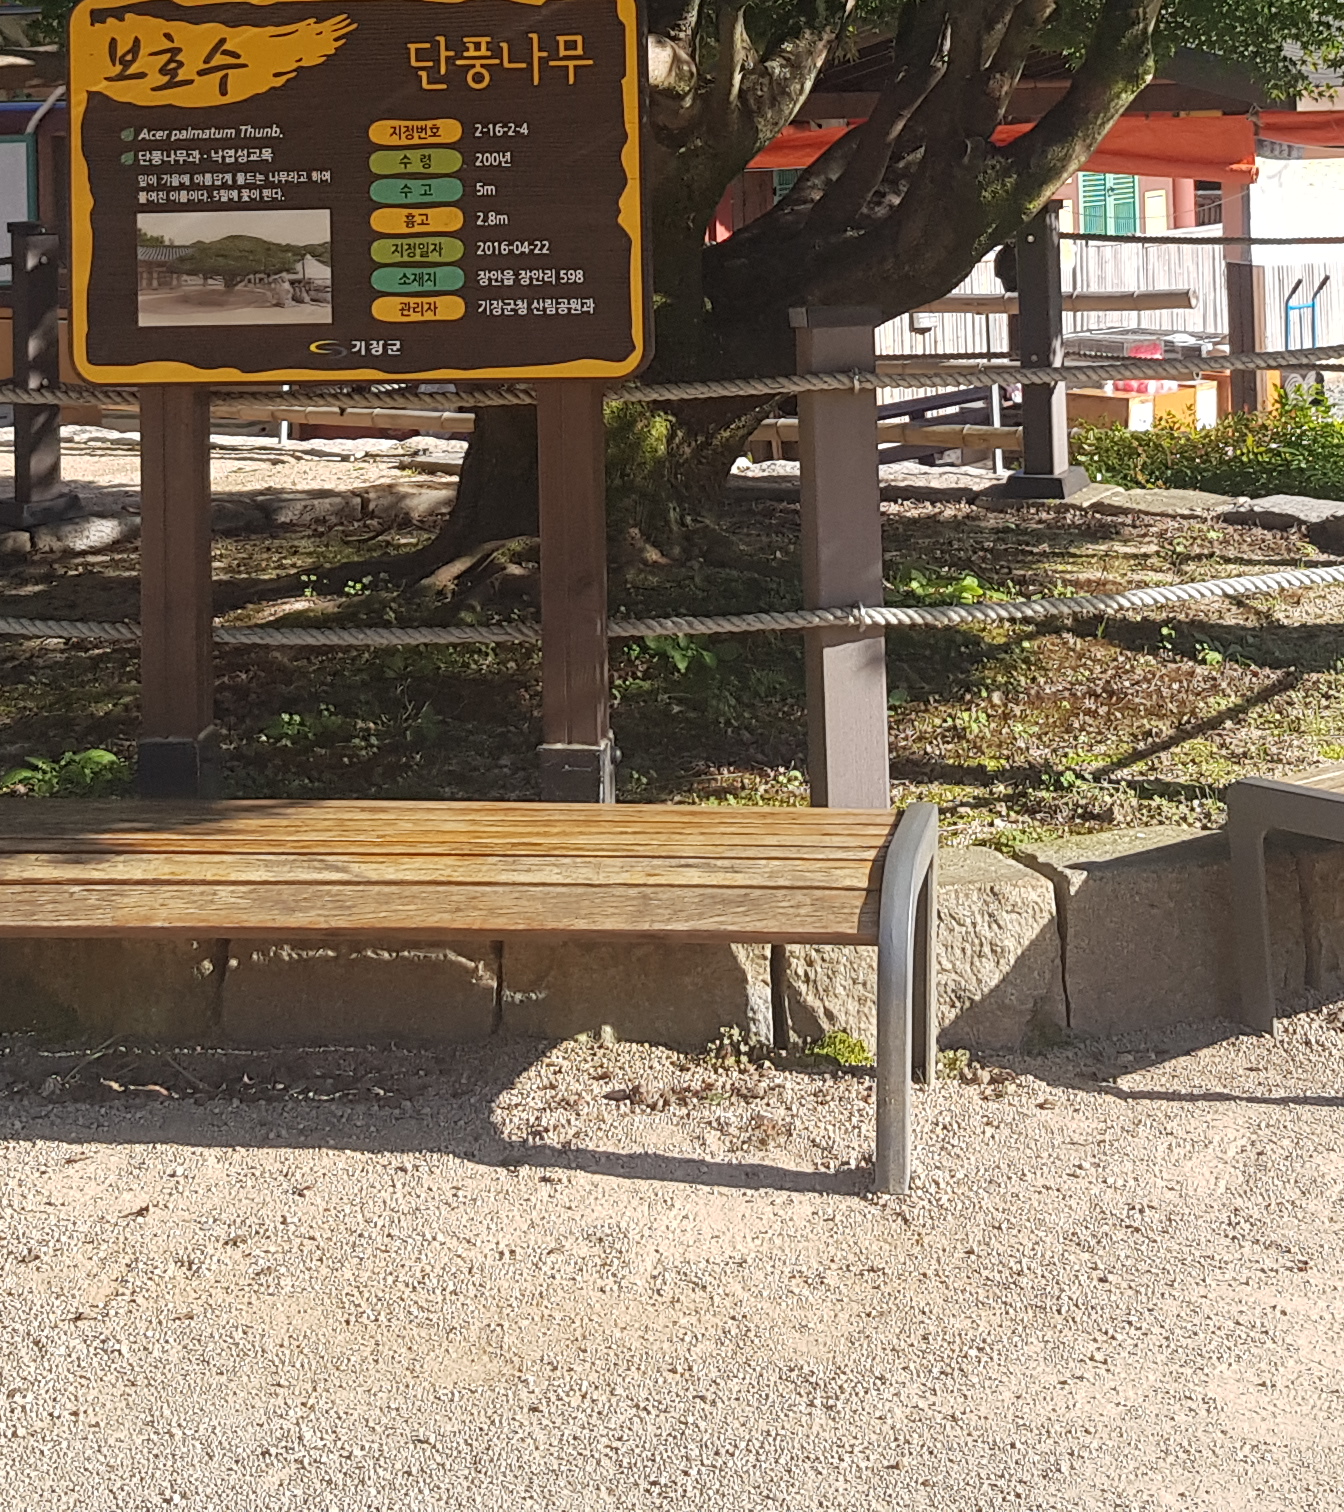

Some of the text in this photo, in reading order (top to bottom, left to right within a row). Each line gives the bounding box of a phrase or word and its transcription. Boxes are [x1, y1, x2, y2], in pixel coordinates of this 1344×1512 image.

[103, 33, 249, 96] 보호수
[406, 32, 594, 90] 단풍나무
[137, 123, 284, 142] Acer palmatum Thunb.
[389, 123, 442, 141] 지정번호
[474, 122, 529, 137] 2-16-2-4
[138, 149, 201, 166] 단풍나무과
[210, 147, 274, 164] 낙엽성교목
[474, 151, 512, 167] 200년
[160, 173, 191, 187] 가을에
[193, 172, 233, 186] 아름답게
[235, 172, 266, 186] 물드는
[268, 170, 309, 184] 나무라고
[311, 170, 331, 184] 하여
[169, 189, 211, 203] 이름이다.
[212, 189, 239, 202] 5월에
[239, 188, 260, 202] 꽃이
[261, 187, 285, 201] 핀다.
[476, 182, 496, 196] 5m
[403, 212, 431, 229] 흉고
[476, 211, 509, 226] 2.8m
[391, 241, 444, 259] 지정일자
[476, 240, 550, 255] 2016-04-22
[397, 271, 437, 288] 소재지
[476, 268, 584, 286] 장안읍 장안리 598
[398, 300, 439, 317] 관리자
[477, 297, 596, 316] 기장군청 산림공원과
[351, 340, 401, 356] 기장군
